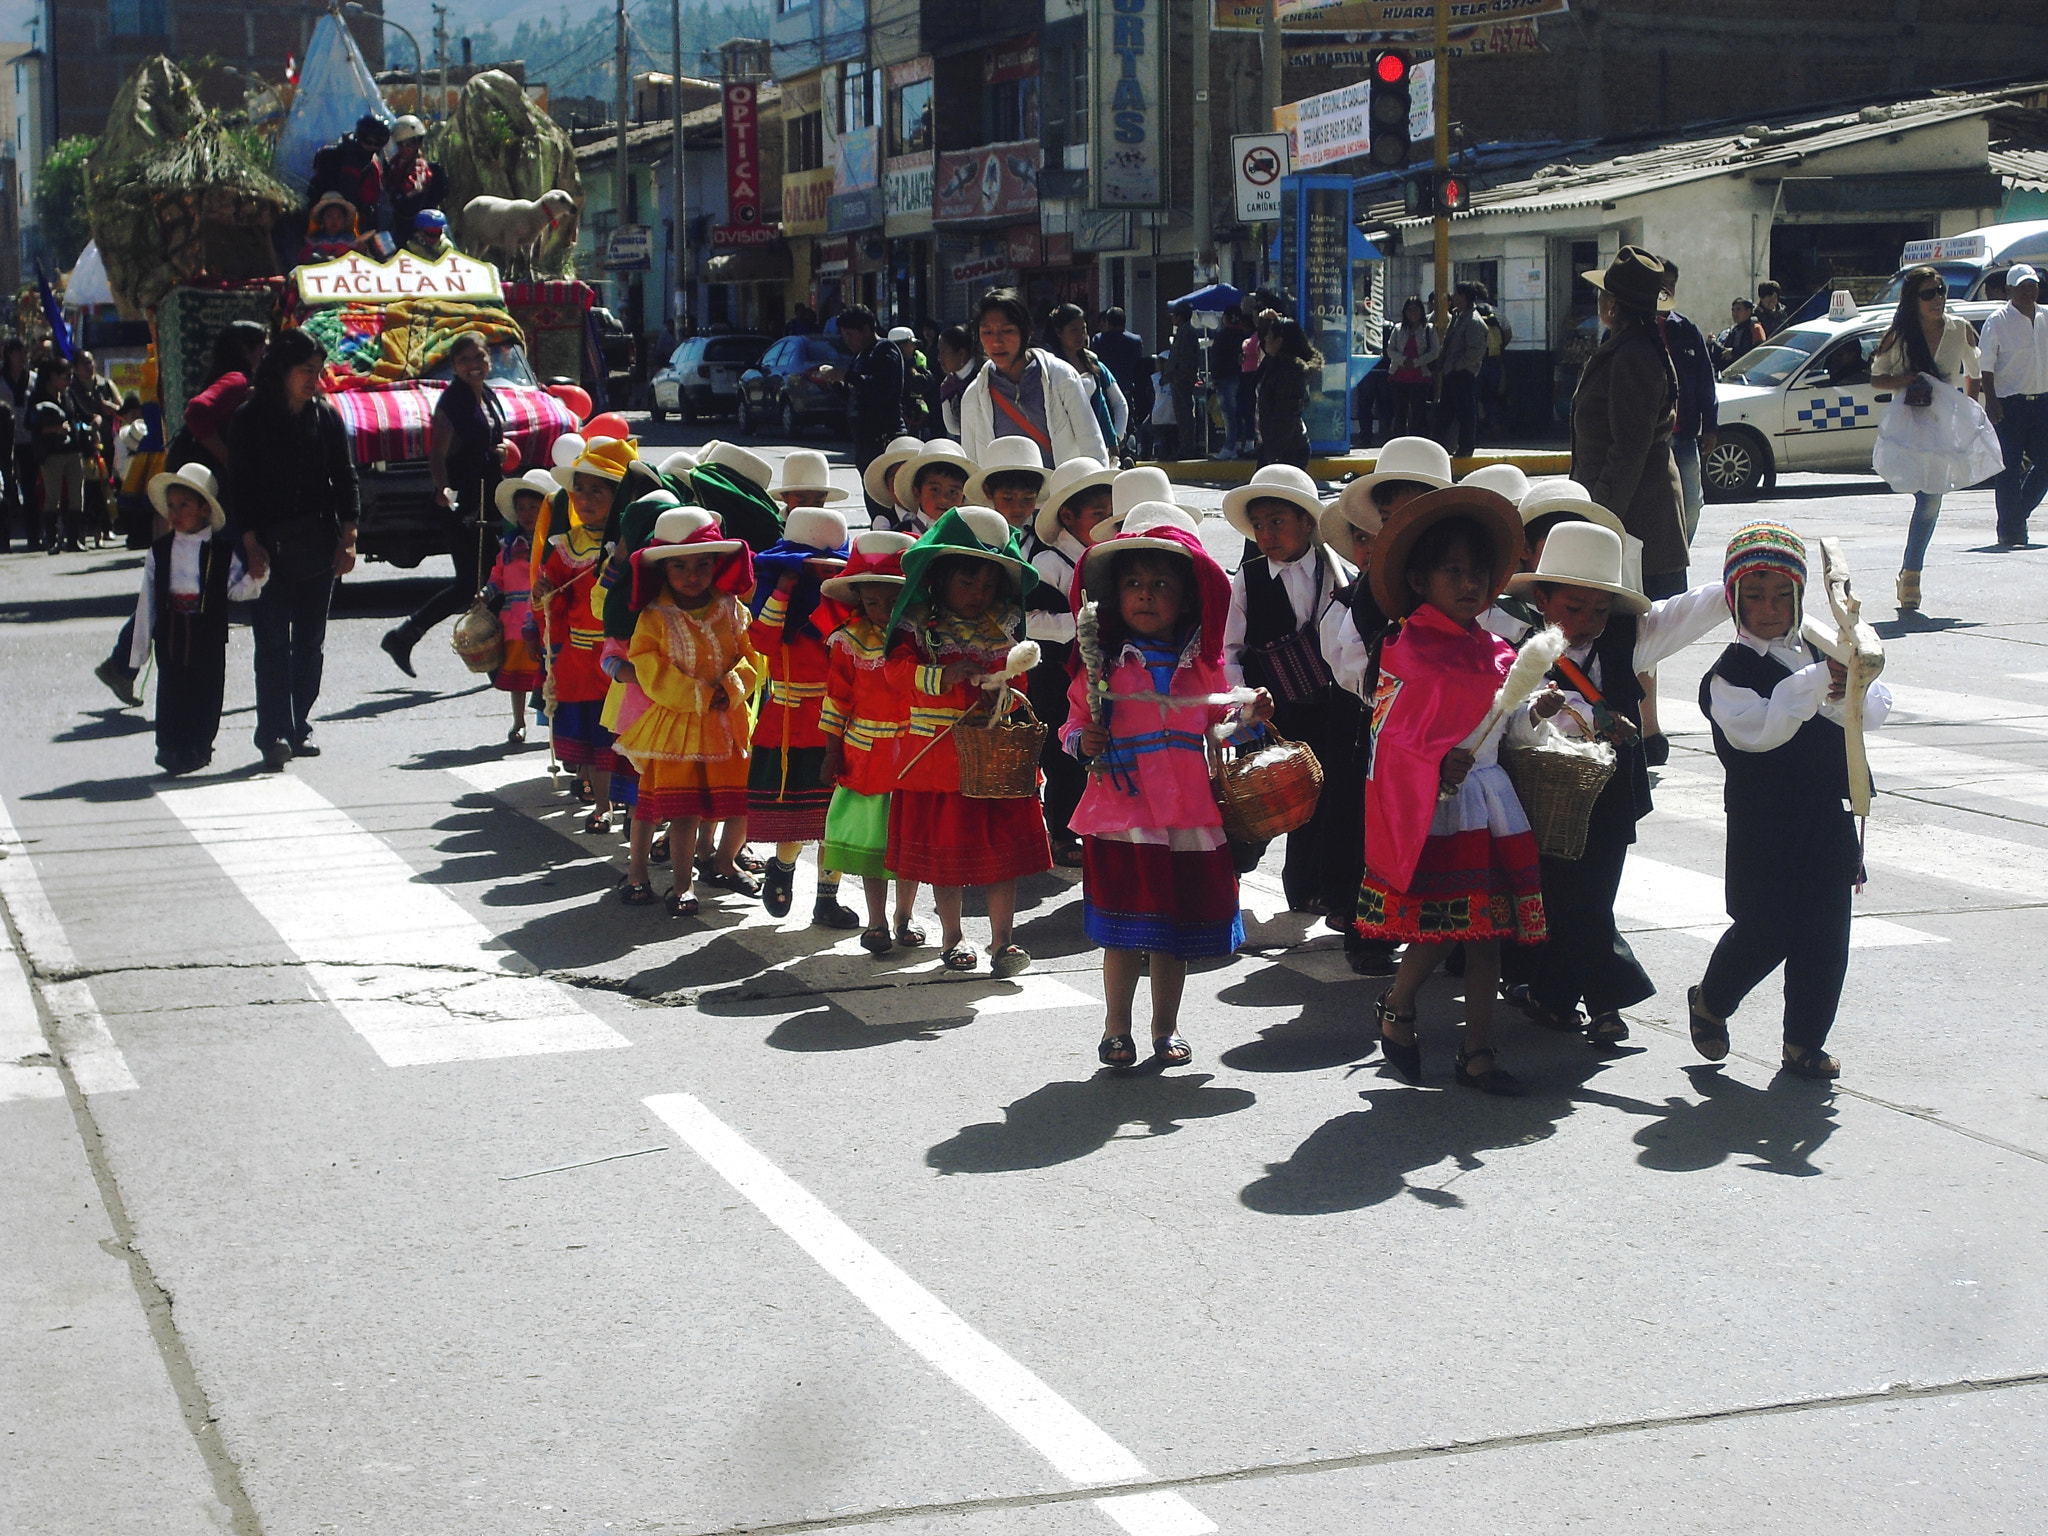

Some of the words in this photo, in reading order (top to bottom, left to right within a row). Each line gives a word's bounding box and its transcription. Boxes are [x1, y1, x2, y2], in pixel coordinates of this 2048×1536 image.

[1233, 8, 1264, 16] DIRIG
[1281, 11, 1325, 23] ENERAL
[1382, 6, 1436, 19] HUARA
[1257, 190, 1271, 200] NO
[1310, 214, 1336, 222] Llama
[1310, 224, 1334, 233] desde
[348, 258, 371, 274] I.
[399, 258, 422, 274] E.
[448, 257, 471, 273] I.
[1321, 265, 1340, 273] todo
[307, 275, 466, 293] TACLLAN
